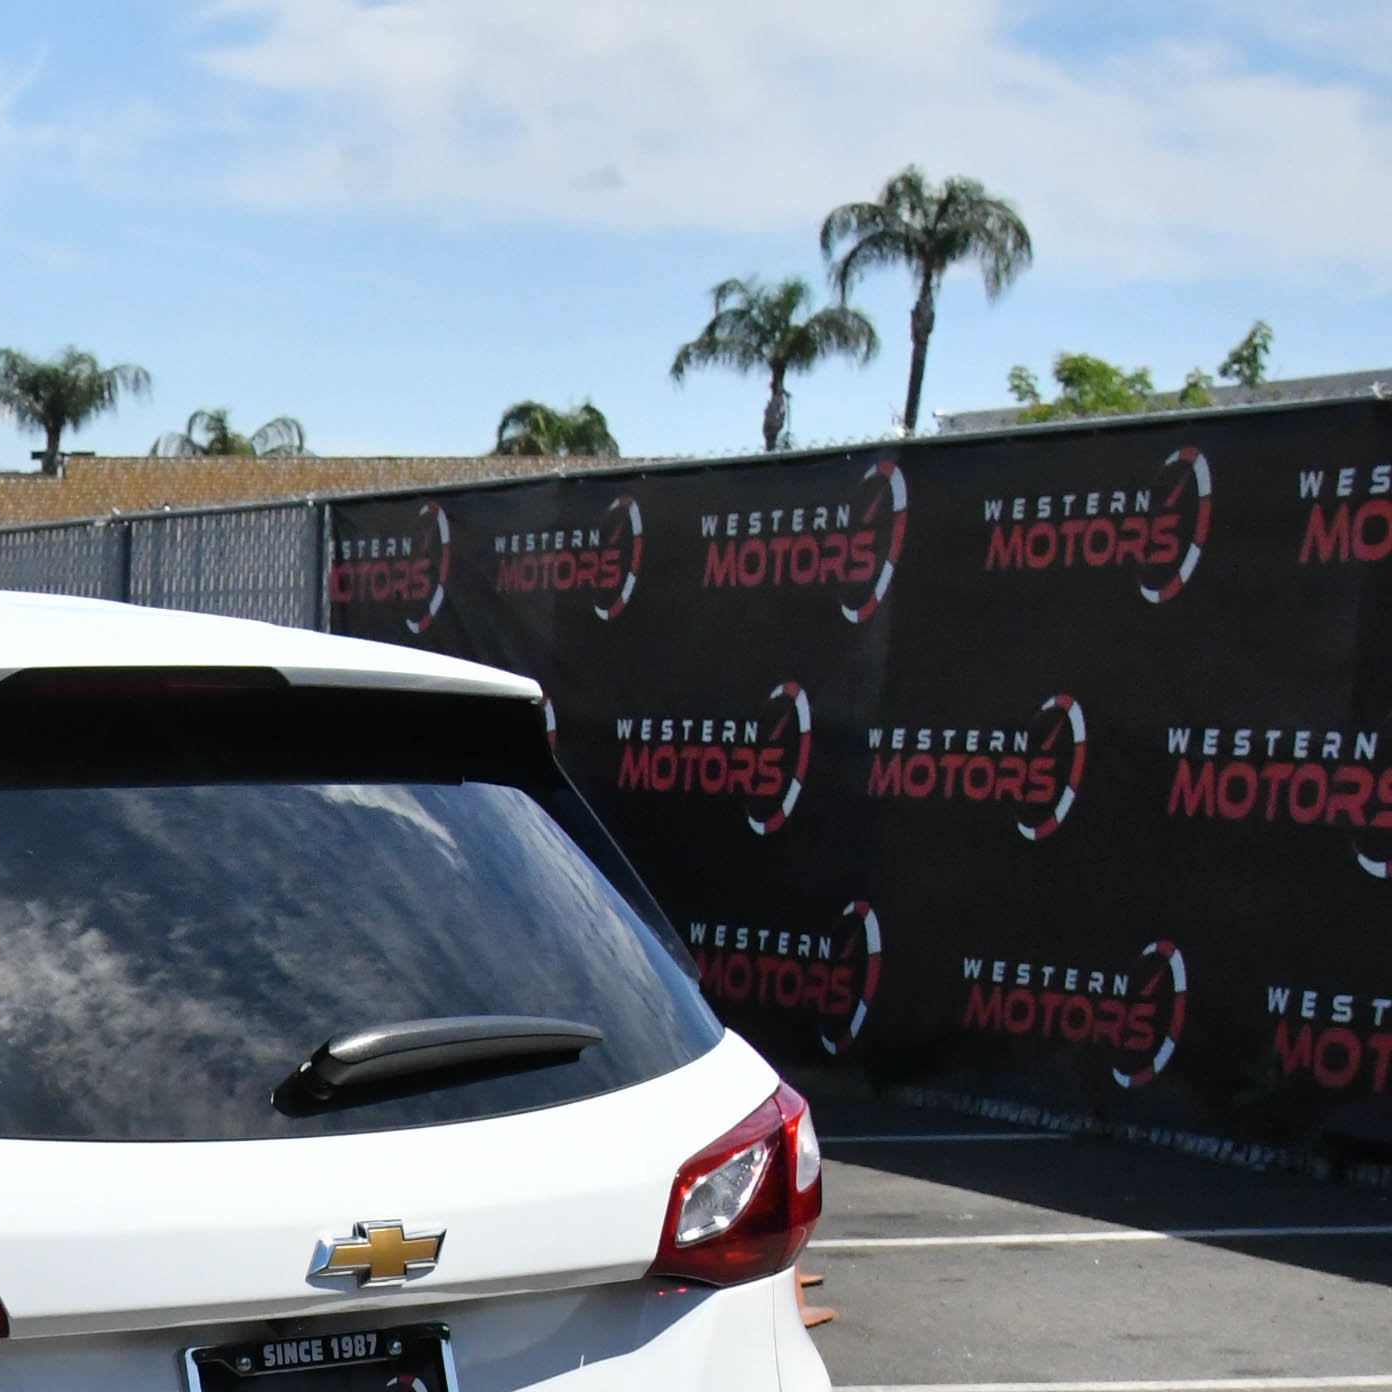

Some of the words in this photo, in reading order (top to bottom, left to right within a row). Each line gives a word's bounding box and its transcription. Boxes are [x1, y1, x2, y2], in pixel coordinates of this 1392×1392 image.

[701, 504, 851, 537] WESTERN
[985, 490, 1151, 521] WESTERN
[495, 529, 600, 553] WESTERN
[703, 530, 875, 588] MOTORS
[986, 513, 1180, 571] MOTORS
[497, 549, 621, 591] MOTORS
[617, 718, 758, 743] WESTERN
[869, 728, 1029, 752] WESTERN
[1168, 727, 1378, 760] WESTERN
[619, 745, 784, 796] MOTORS
[869, 754, 1056, 803] MOTORS
[690, 922, 832, 960] WESTERN
[696, 950, 853, 1014] MOTORS
[963, 957, 1129, 996] WESTERN
[963, 983, 1156, 1050] MOTORS
[263, 1339, 324, 1367] SINCE
[330, 1334, 377, 1360] 1987
